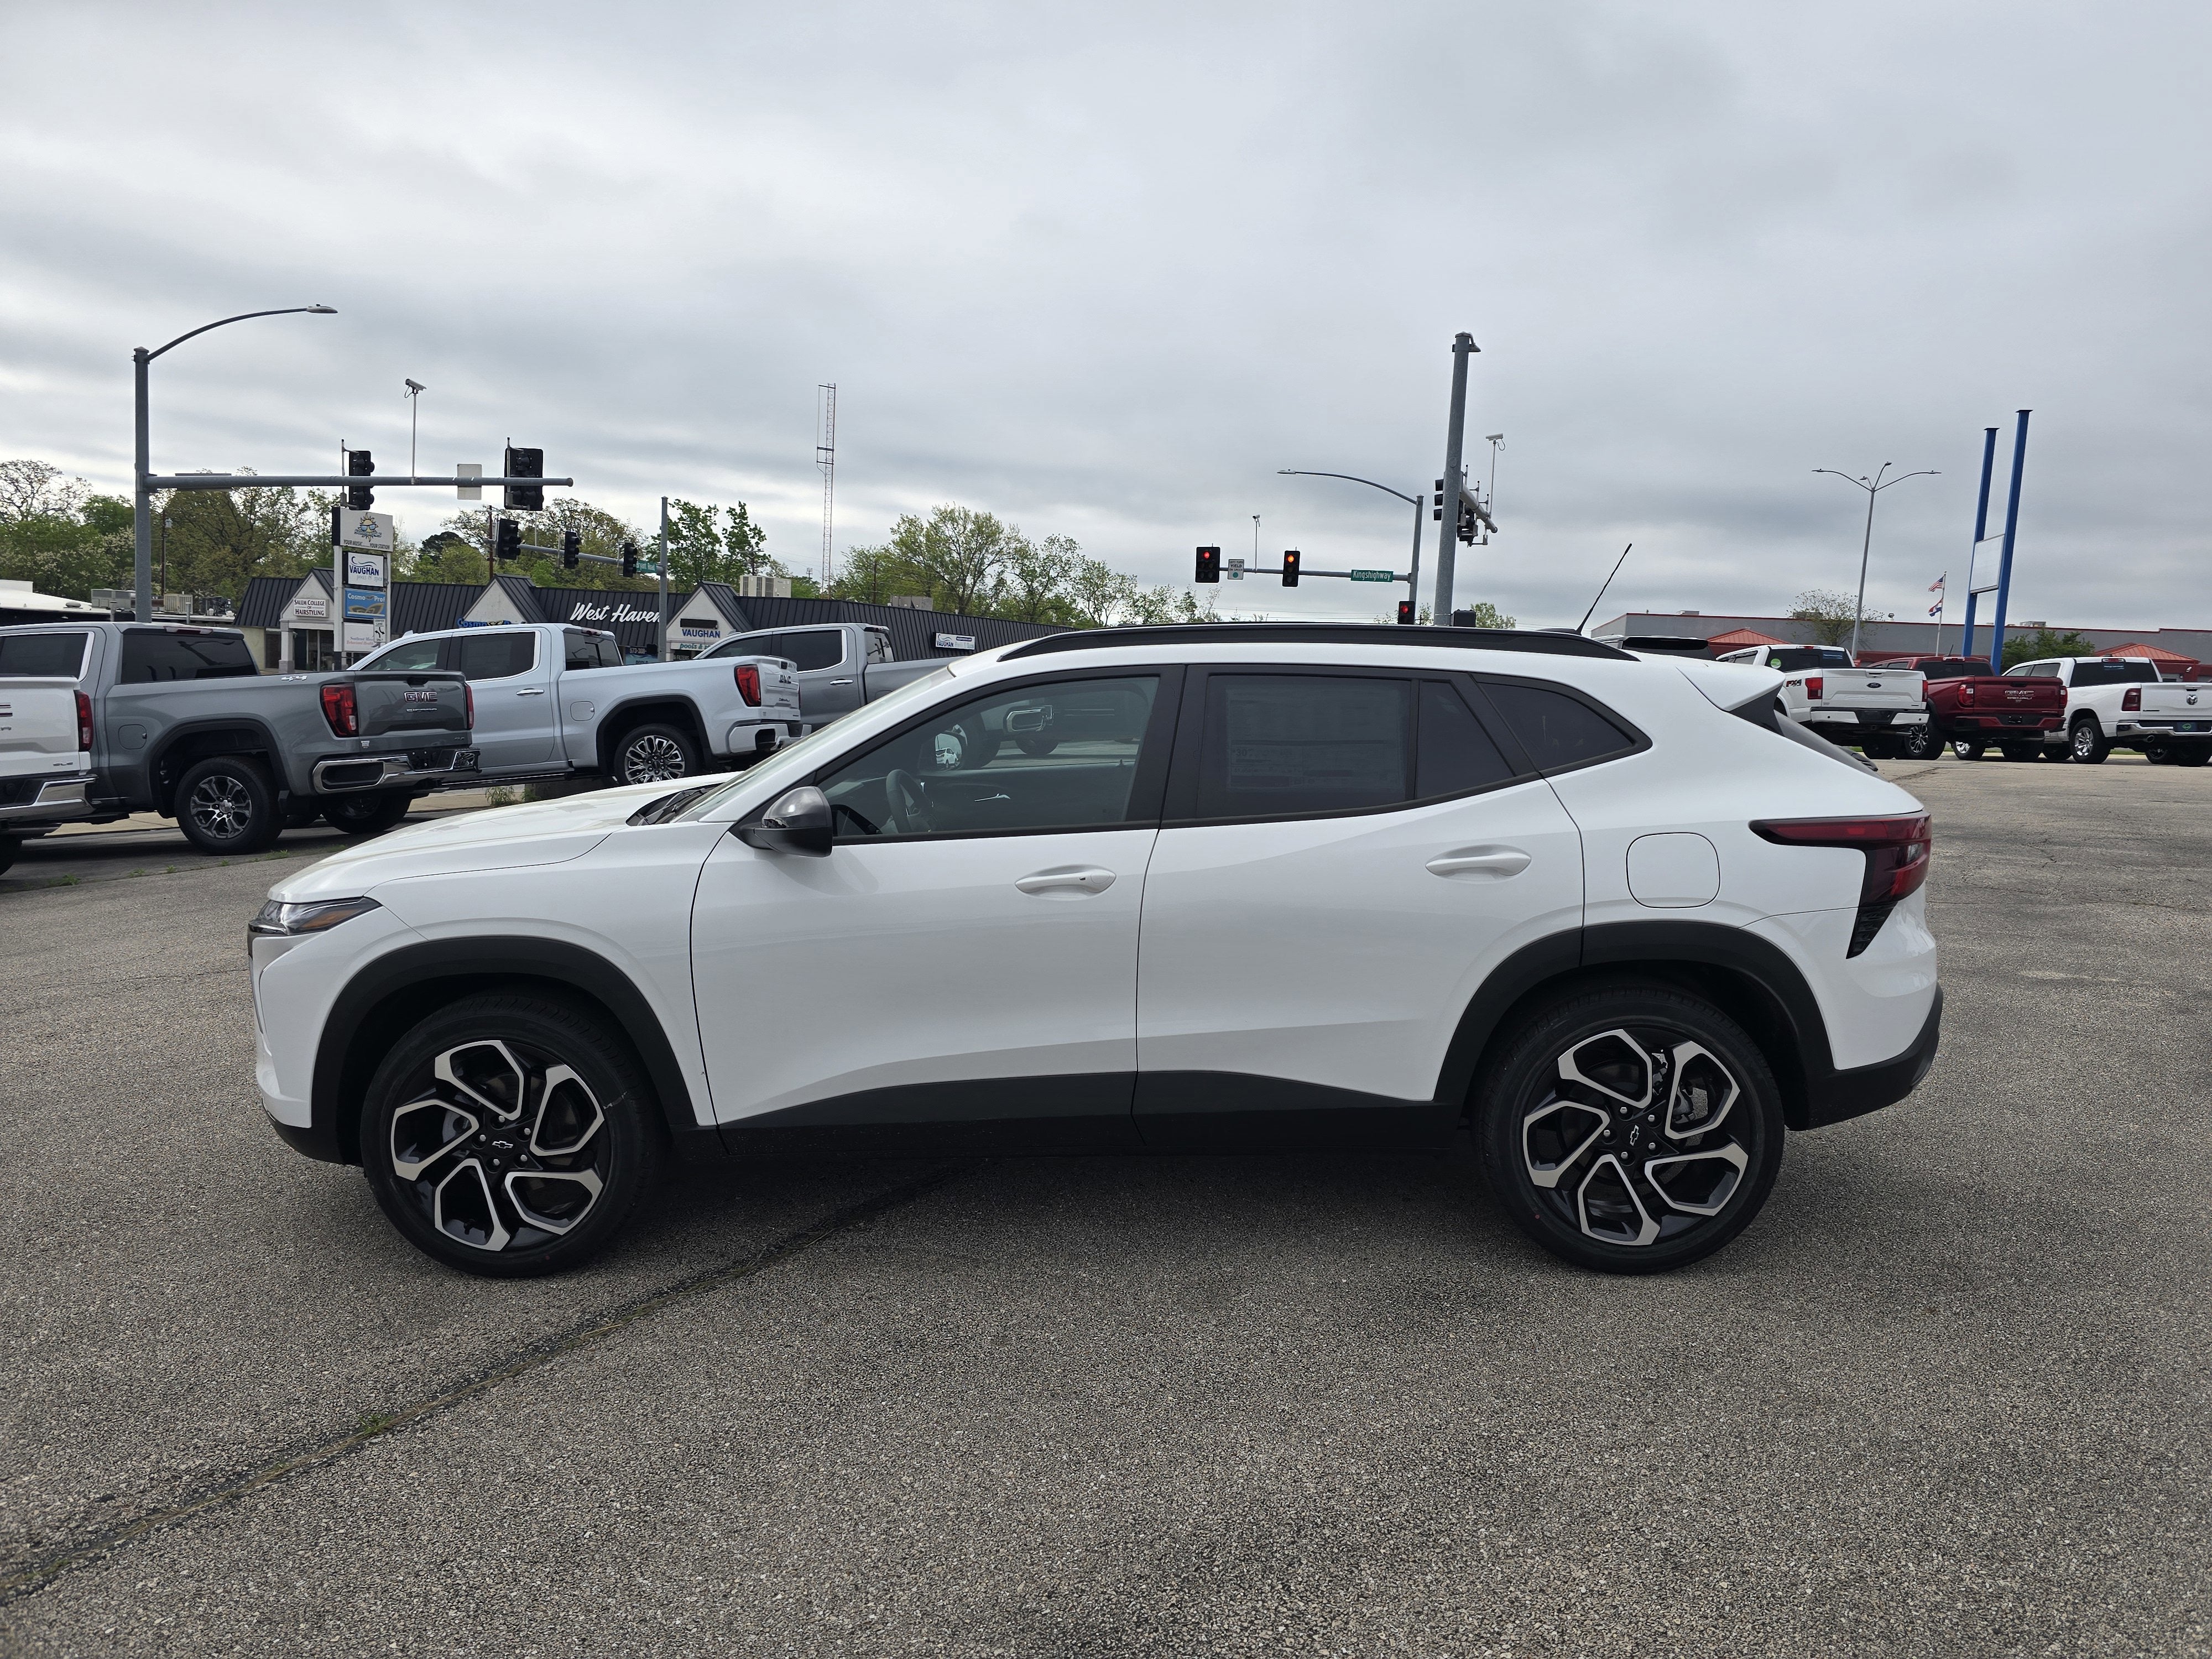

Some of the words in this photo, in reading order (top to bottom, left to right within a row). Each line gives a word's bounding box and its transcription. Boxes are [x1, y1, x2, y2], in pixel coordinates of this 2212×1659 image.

[349, 565, 379, 576] VAUGHAN
[1353, 570, 1391, 581] Kingshighway
[570, 602, 610, 621] West
[682, 629, 720, 638] VAUGHAN
[1786, 679, 1802, 687] FX4
[404, 692, 438, 703] GMC
